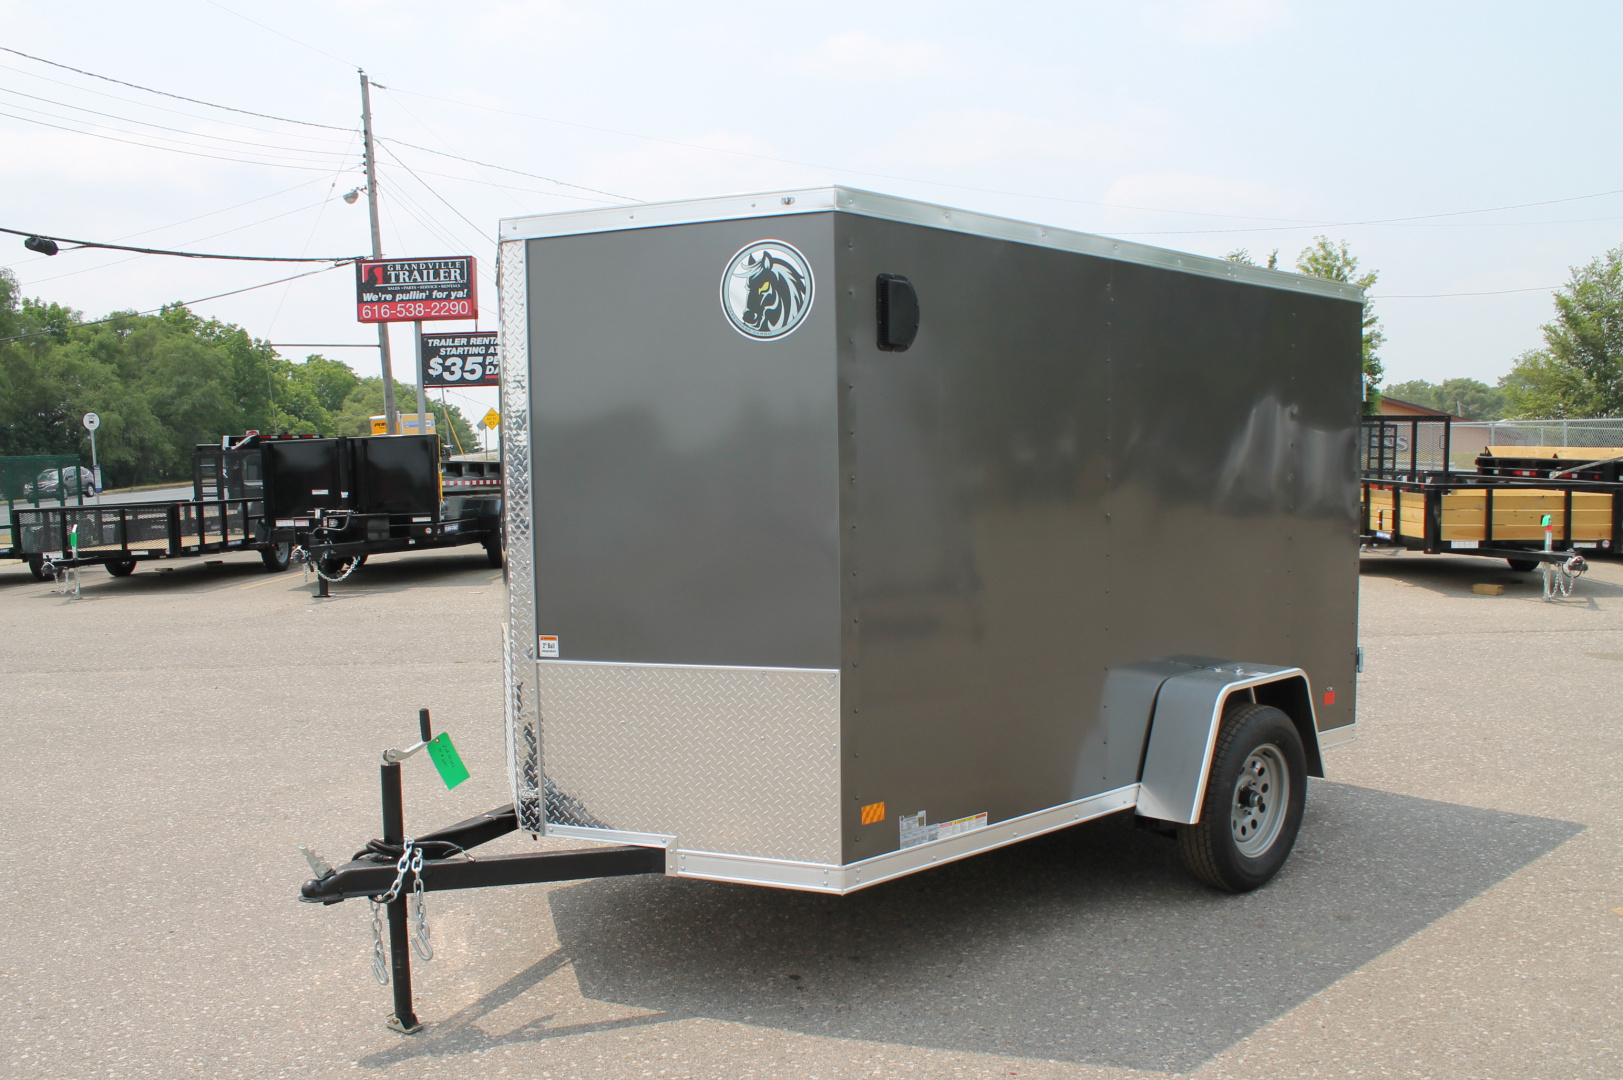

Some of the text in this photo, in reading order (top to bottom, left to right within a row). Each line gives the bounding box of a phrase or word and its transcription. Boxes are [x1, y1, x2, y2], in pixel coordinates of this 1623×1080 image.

[387, 261, 461, 271] GRANDVILLE
[387, 268, 461, 283] TRAILER
[362, 289, 468, 302] We're pullin' for ya!
[362, 301, 469, 319] 616-538-2290
[428, 338, 467, 347] TRAILER
[440, 346, 486, 355] STARTING
[428, 356, 484, 381] $35
